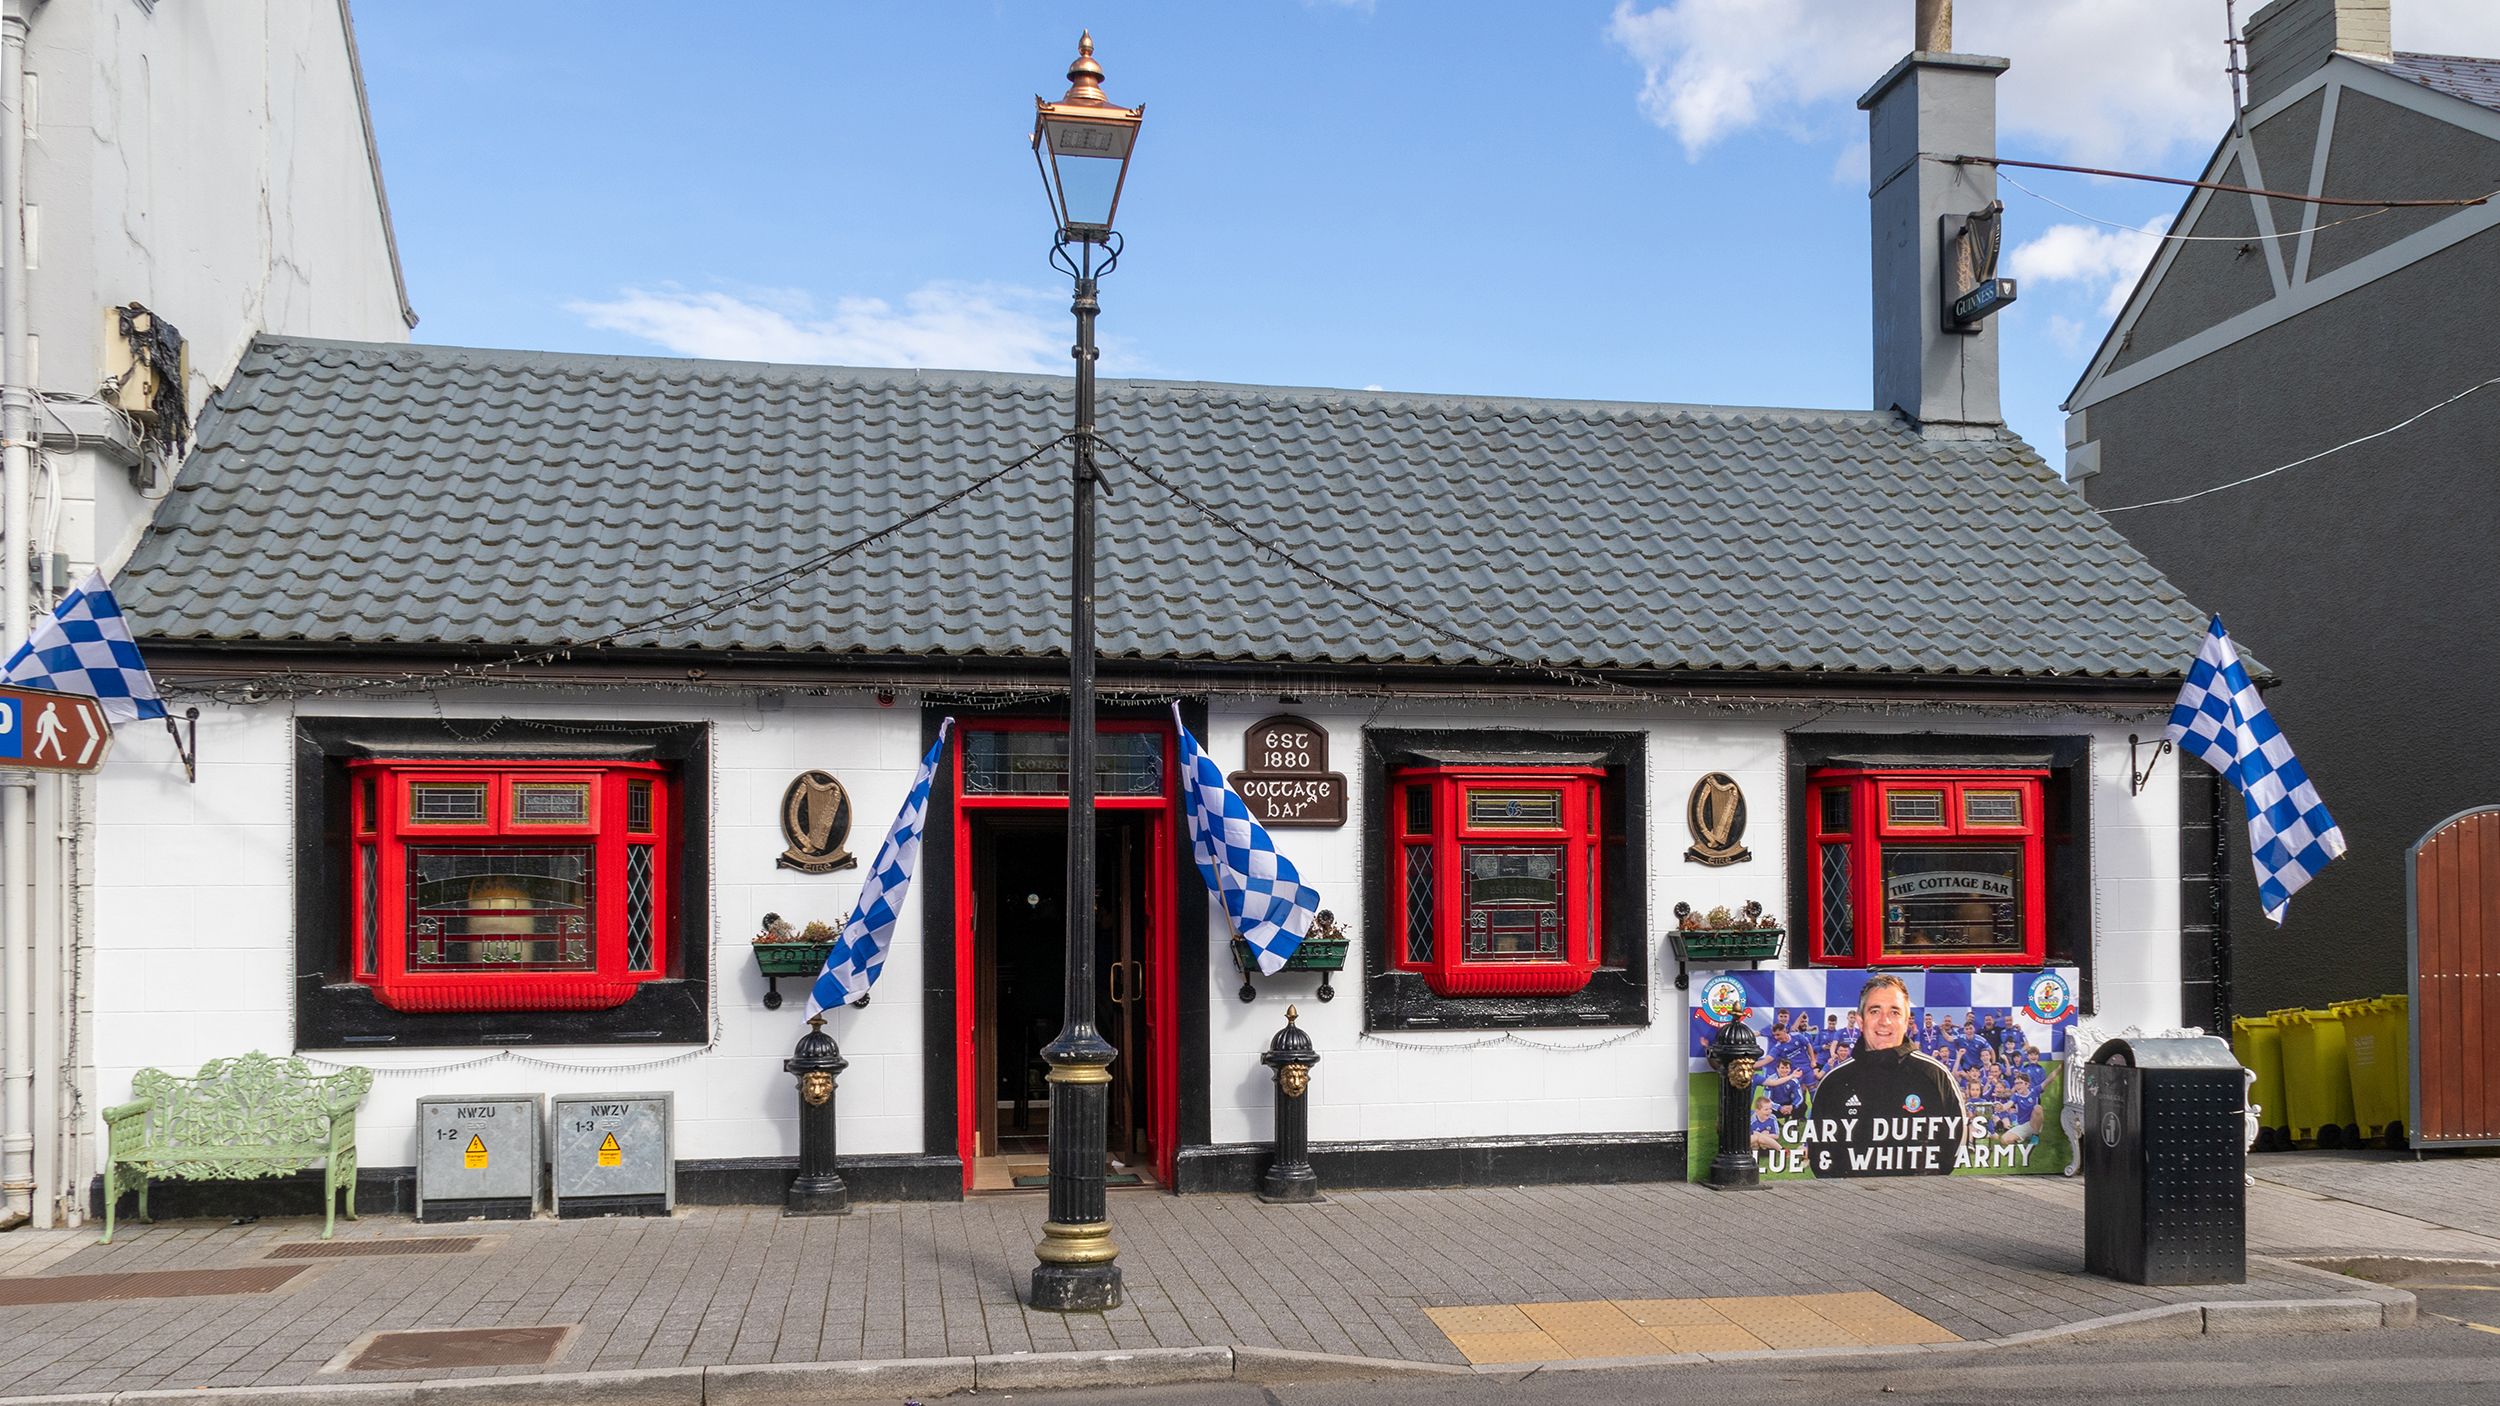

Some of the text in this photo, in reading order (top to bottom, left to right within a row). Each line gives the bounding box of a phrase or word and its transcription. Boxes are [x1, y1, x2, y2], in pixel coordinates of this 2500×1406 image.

[1956, 286, 1994, 316] GUINNESS
[1264, 751, 1310, 768] 1880
[1243, 781, 1330, 803] COTTAGE
[1890, 877, 2009, 896] THE COTTAGE BAR
[1704, 976, 1744, 993] BUNCRANA HEARTS
[457, 1106, 496, 1118] NWZU
[591, 1104, 629, 1116] NWZV
[437, 1129, 458, 1140] 1-2
[576, 1121, 594, 1132] 1-3
[1782, 1116, 1988, 1143] GARY DUFFY'S
[1752, 1143, 2035, 1173] LUE & WHITE ARMY
